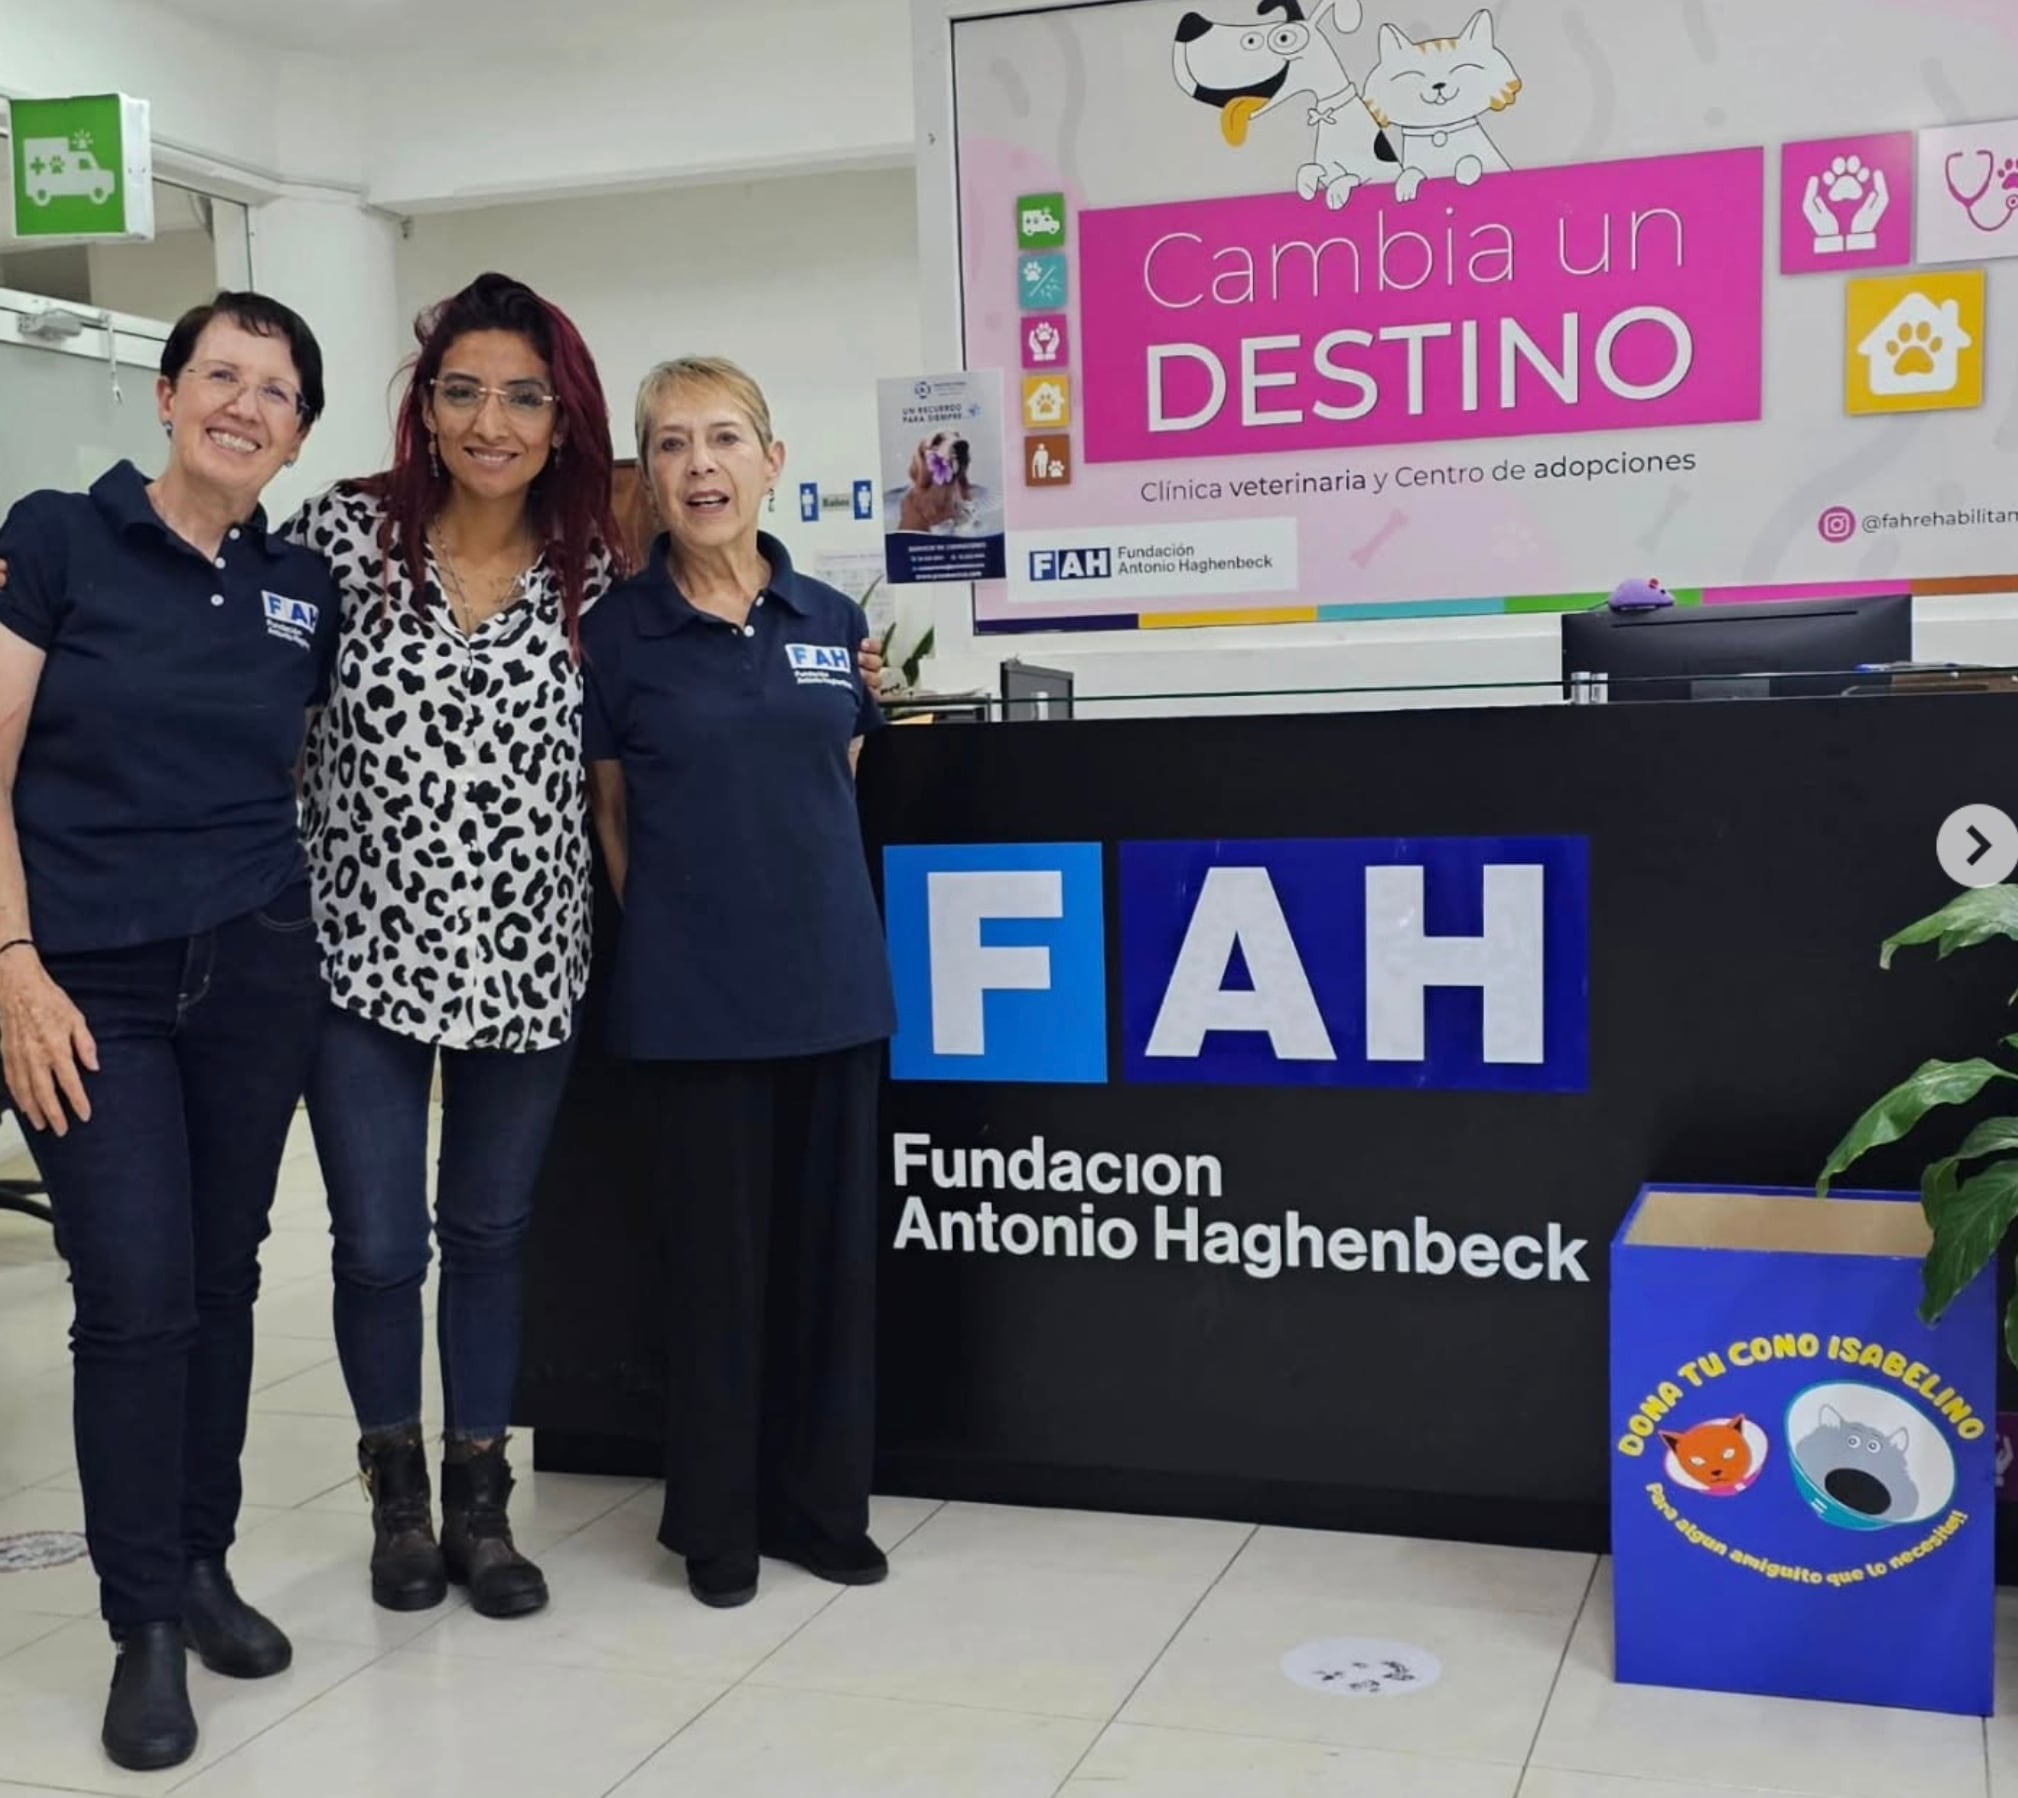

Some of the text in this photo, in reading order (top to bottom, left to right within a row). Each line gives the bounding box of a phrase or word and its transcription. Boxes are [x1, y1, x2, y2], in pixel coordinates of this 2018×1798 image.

[1143, 206, 1686, 310] Cambia un
[1146, 306, 1695, 434] DESTINO
[1141, 451, 1696, 502] Clínica veterinaria y Centro de adopciones
[1033, 551, 1108, 580] FAH
[1118, 544, 1195, 559] Fundación
[1118, 555, 1273, 575] Antonio Haghenbeck
[791, 646, 849, 669] FAH
[927, 863, 1545, 1065] FAH
[892, 1196, 1591, 1283] Antonio Haghenbeck
[1618, 1332, 1986, 1457] DONA TU CONO ISABELINO
[1729, 1549, 1823, 1585] amiguito
[1826, 1567, 1865, 1587] que
[1866, 1562, 1888, 1578] lo
